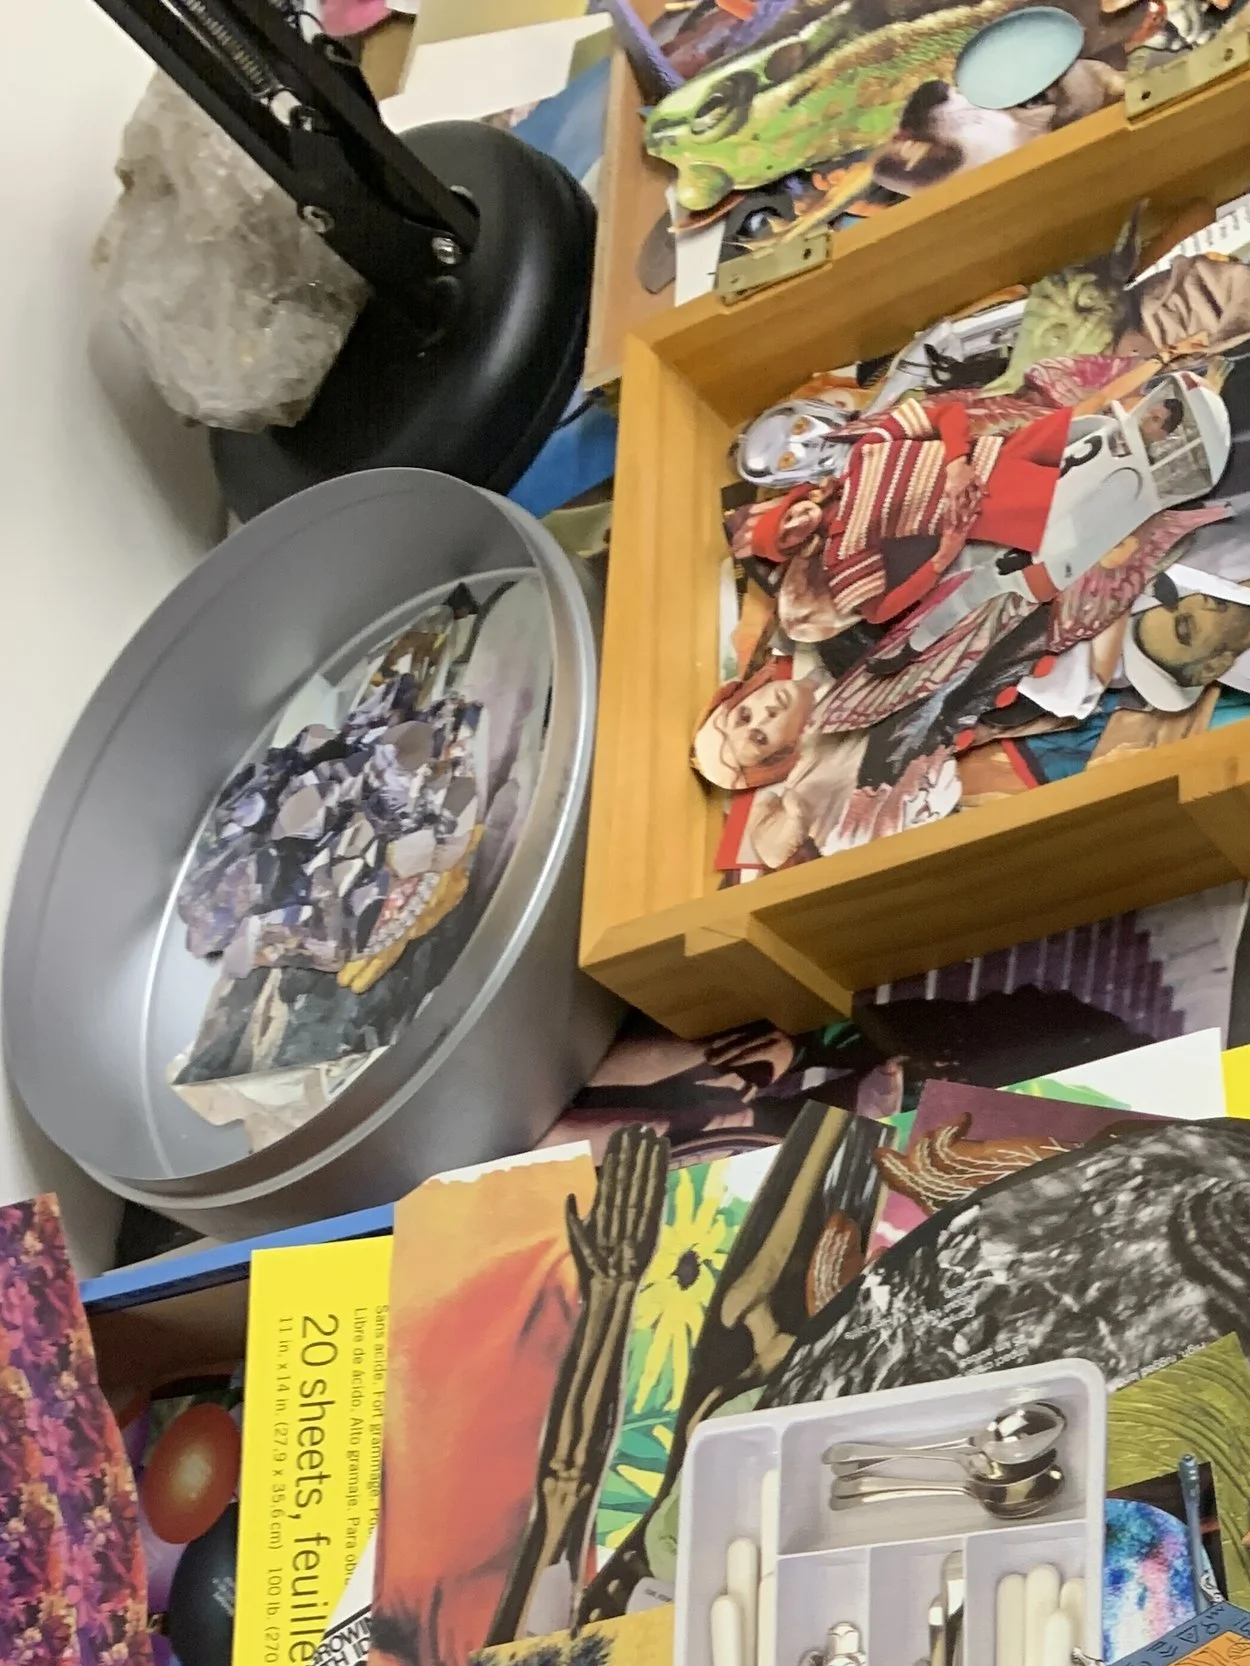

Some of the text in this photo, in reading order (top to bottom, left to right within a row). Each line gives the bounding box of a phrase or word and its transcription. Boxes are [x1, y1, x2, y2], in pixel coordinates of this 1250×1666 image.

[278, 1316, 292, 1336] 11
[300, 1314, 339, 1367] 20
[350, 1307, 365, 1346] Libre
[276, 1339, 291, 1358] in.
[351, 1352, 364, 1366] de
[276, 1363, 287, 1371] x
[276, 1375, 290, 1393] 14
[349, 1371, 365, 1413] ácido.
[274, 1397, 289, 1417] in.
[272, 1422, 289, 1463] (27.9
[348, 1417, 364, 1446] Alto
[290, 1379, 335, 1520] sheets,
[272, 1469, 283, 1477] x
[345, 1449, 362, 1511] gramaje.
[270, 1483, 285, 1518] 35.6
[345, 1516, 360, 1549] Para
[267, 1567, 283, 1596] 100
[265, 1601, 281, 1621] lb.
[263, 1626, 279, 1663] (270
